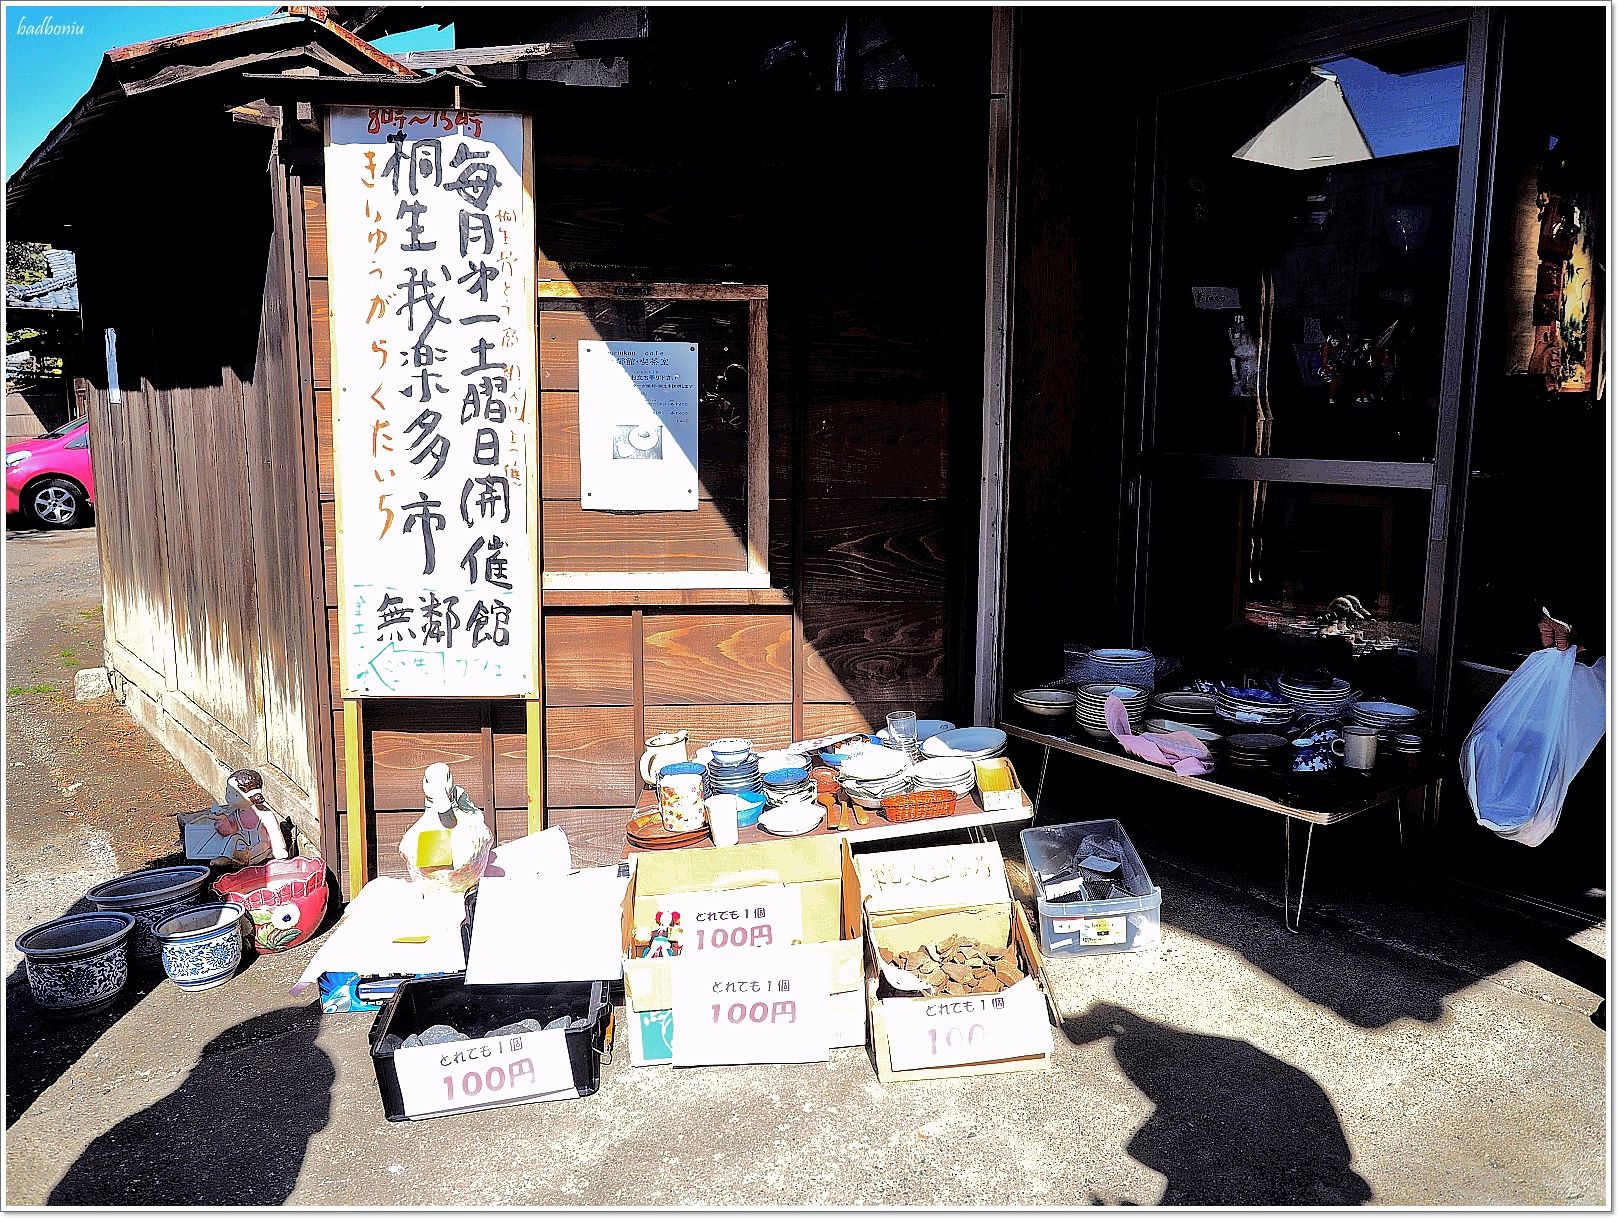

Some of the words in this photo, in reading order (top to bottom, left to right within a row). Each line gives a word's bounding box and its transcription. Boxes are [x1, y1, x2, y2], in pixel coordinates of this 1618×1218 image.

[381, 130, 452, 576] 桐生我楽多市
[696, 924, 774, 951] 100円
[711, 1000, 798, 1024] 100円
[443, 1057, 537, 1101] 100円
